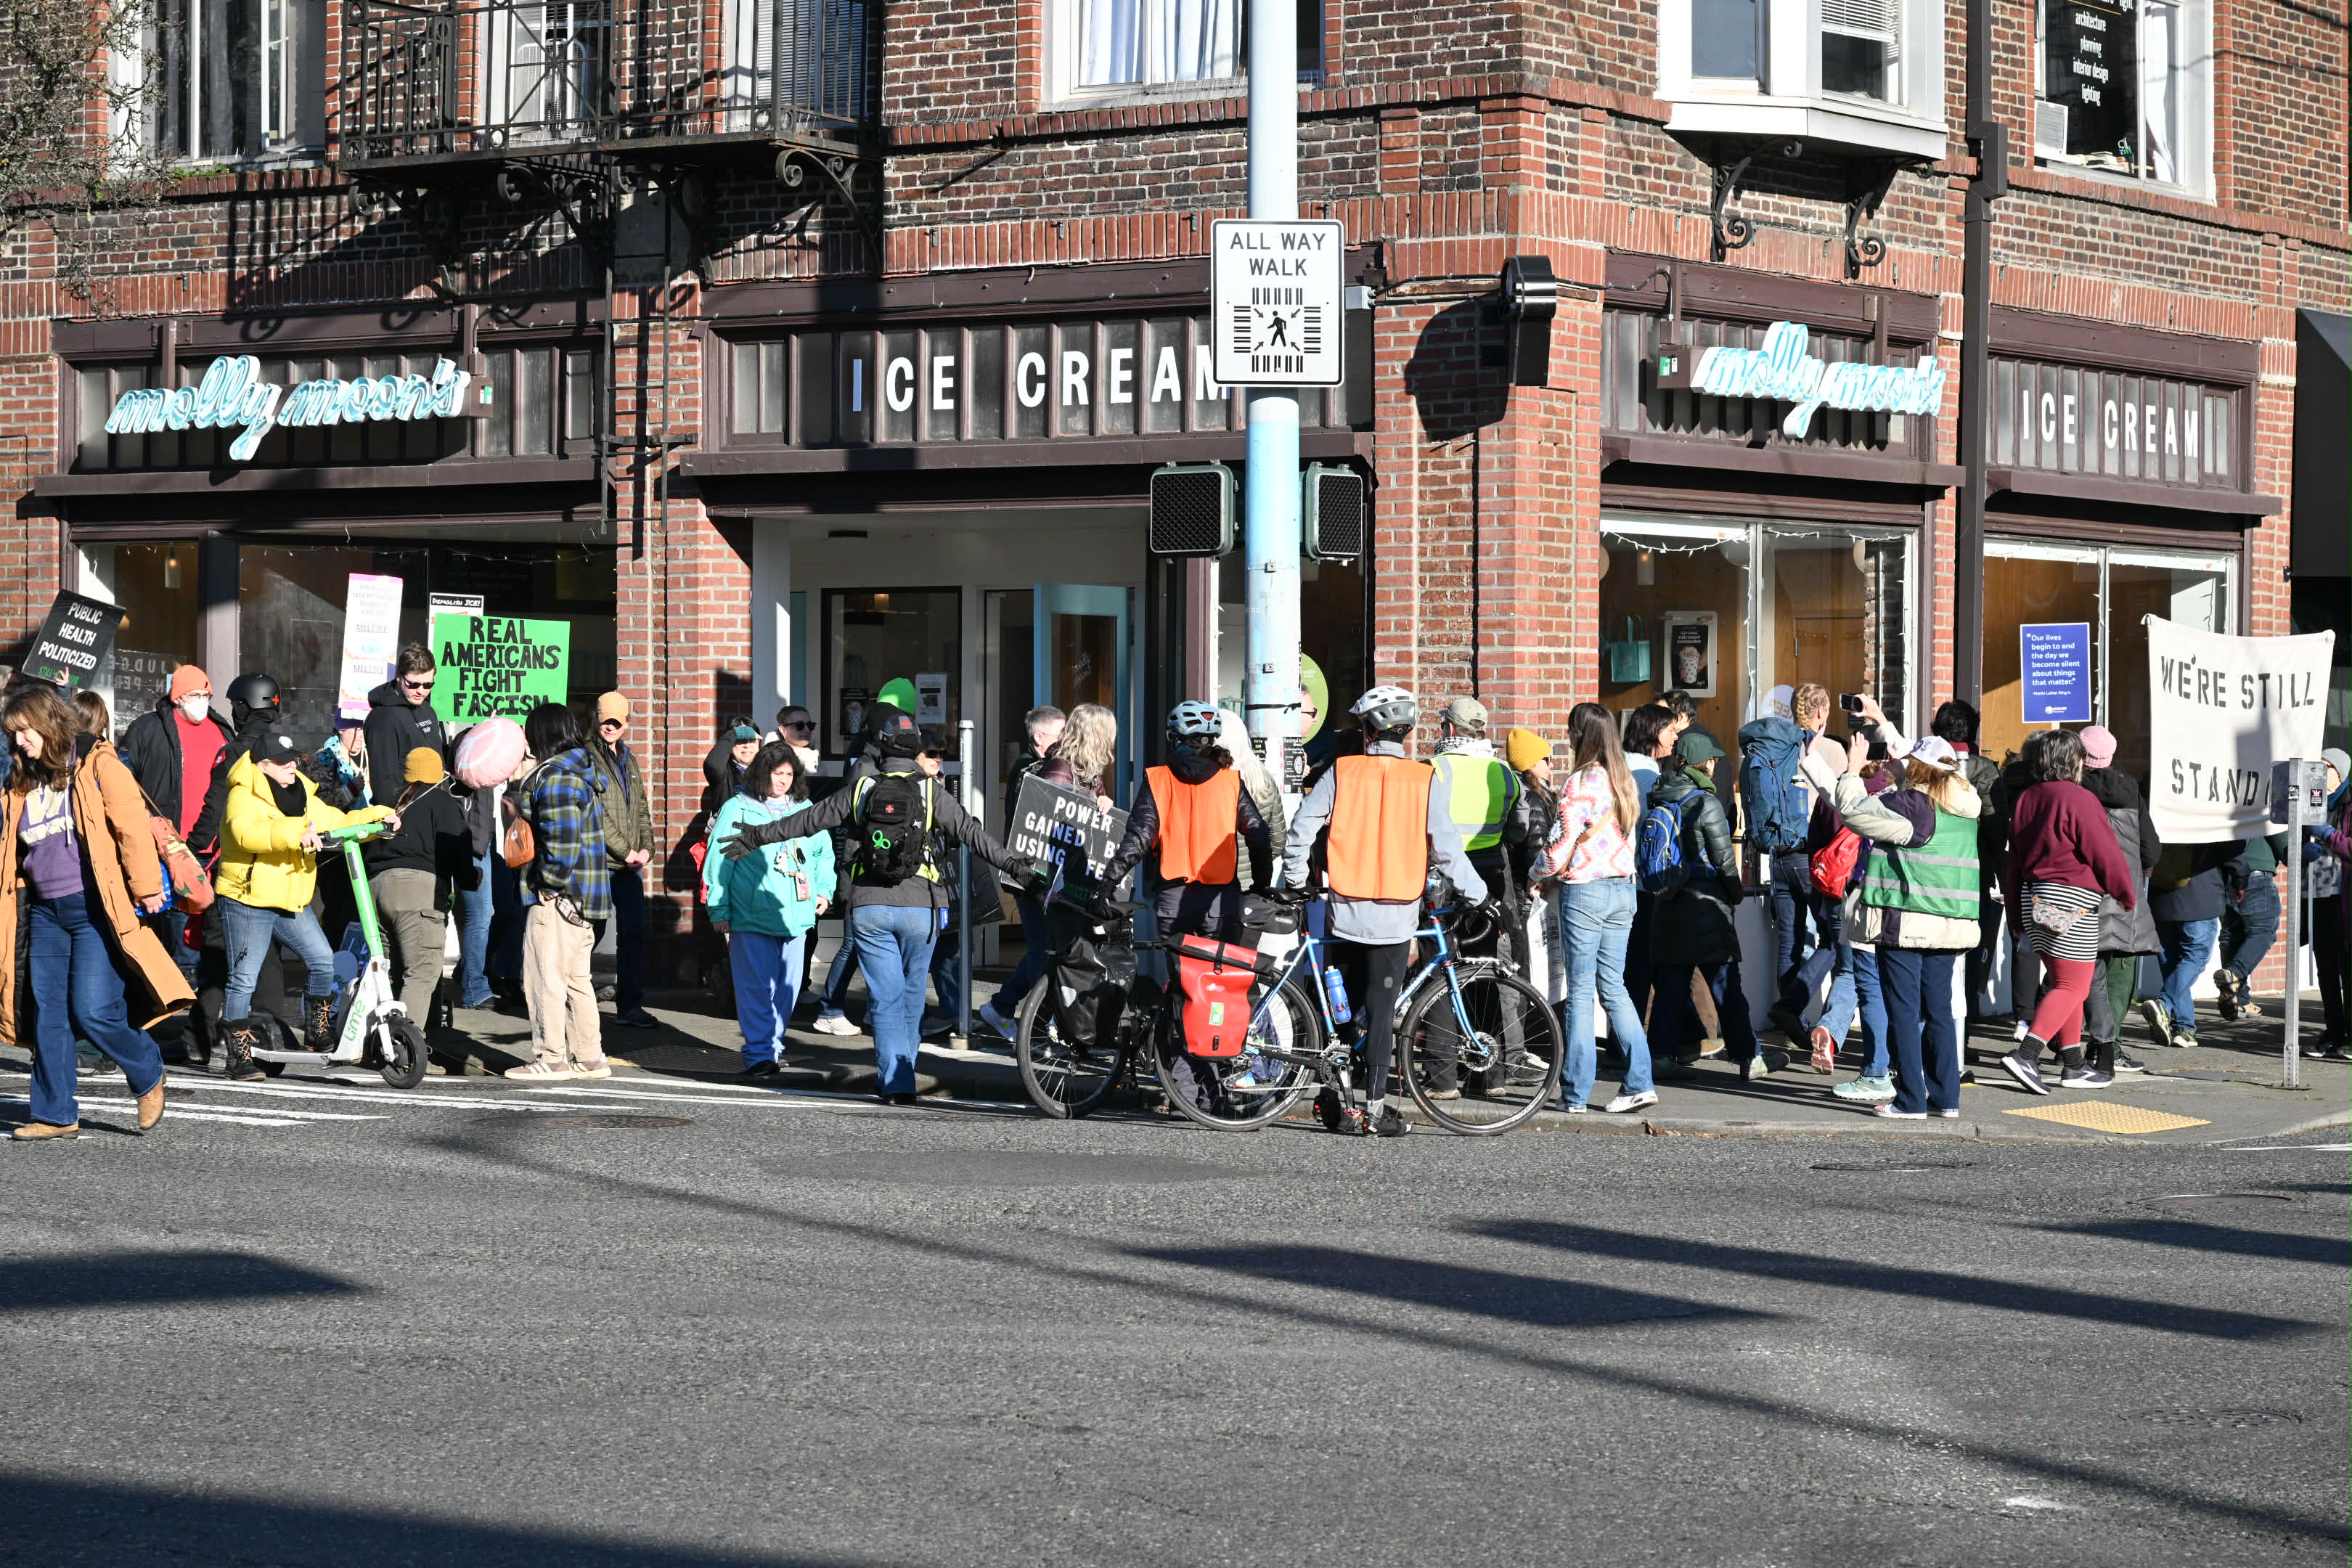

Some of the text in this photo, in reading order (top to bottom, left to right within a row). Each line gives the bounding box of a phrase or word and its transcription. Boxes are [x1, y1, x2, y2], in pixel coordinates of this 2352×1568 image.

[2075, 11, 2107, 32] architecture
[2080, 35, 2102, 58] planning
[2073, 57, 2109, 83] interior design
[2081, 83, 2101, 107] lighting
[1230, 232, 1326, 250] ALL WAY
[1249, 258, 1308, 277] WALK
[853, 344, 1230, 412] ICE CREAM
[105, 355, 282, 460] molly
[2022, 390, 2200, 459] ICE CREAM
[68, 603, 102, 624] PUBLIC
[432, 597, 481, 608] DEMOLISH ICE!
[58, 622, 97, 646] HEALTH
[470, 616, 533, 645] REAL
[38, 641, 97, 670] POLITICIZED
[441, 641, 562, 669] AMERICANS
[459, 666, 527, 693] FIGHT
[2241, 672, 2315, 710] STILL
[453, 693, 550, 717] FASCISM
[1055, 796, 1113, 833] POWER
[1025, 812, 1120, 859] GAINED B
[1016, 833, 1066, 866] USING
